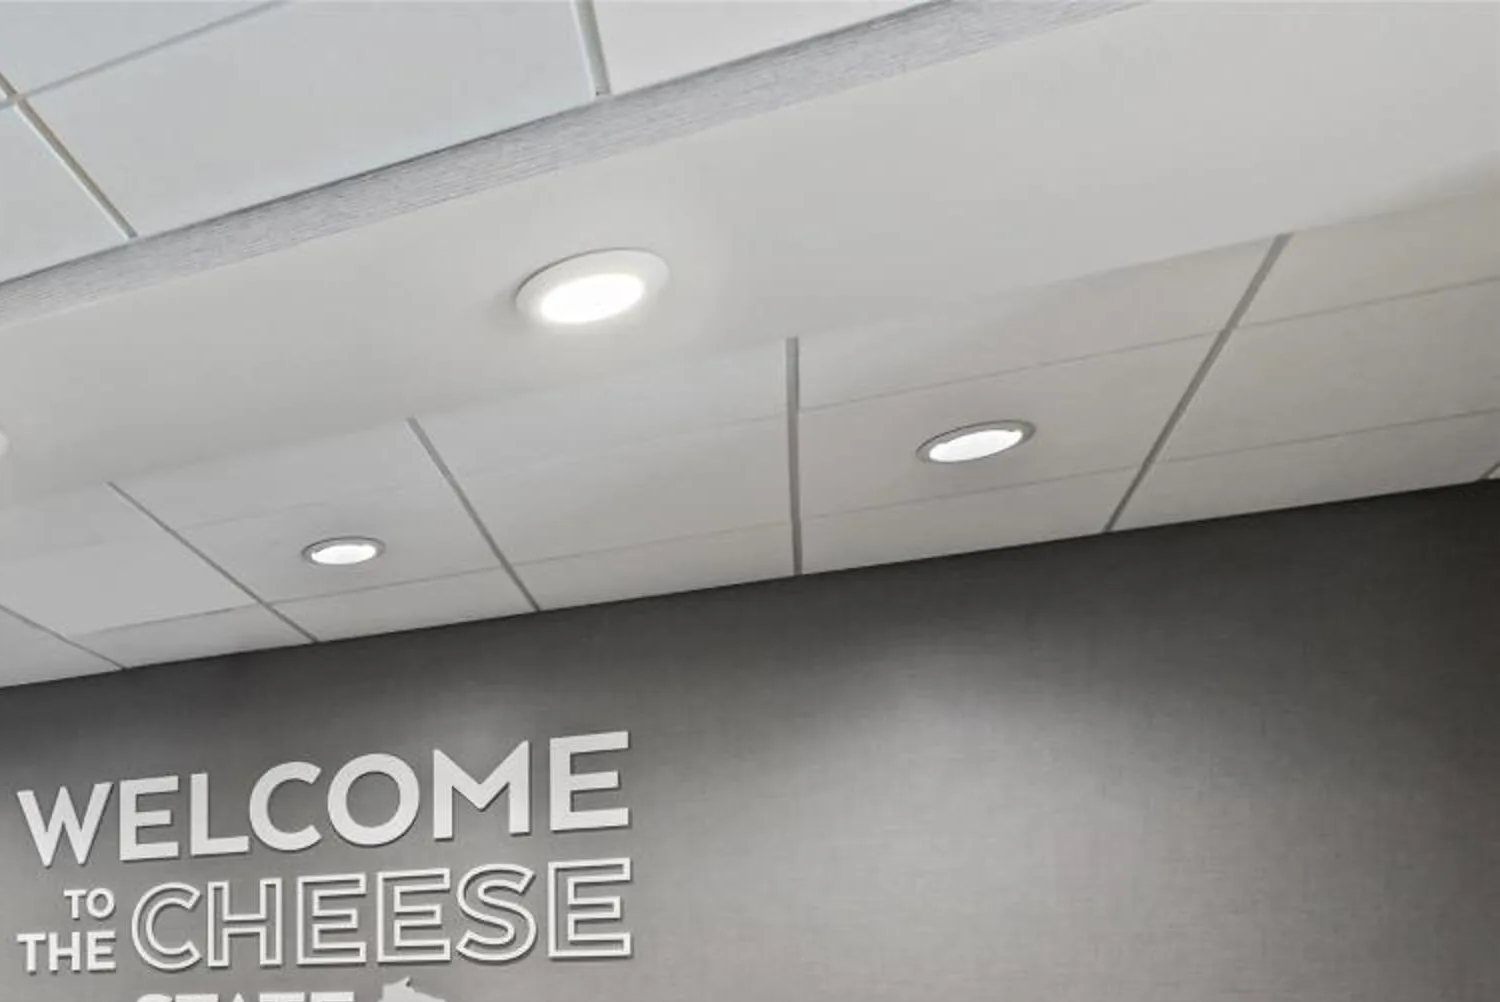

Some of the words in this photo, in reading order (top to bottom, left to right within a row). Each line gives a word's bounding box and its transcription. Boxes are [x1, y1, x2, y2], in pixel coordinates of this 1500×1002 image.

[17, 731, 630, 867] WELCOME
[63, 888, 115, 919] TO
[131, 857, 632, 971] CHEESE
[17, 931, 116, 972] THE
